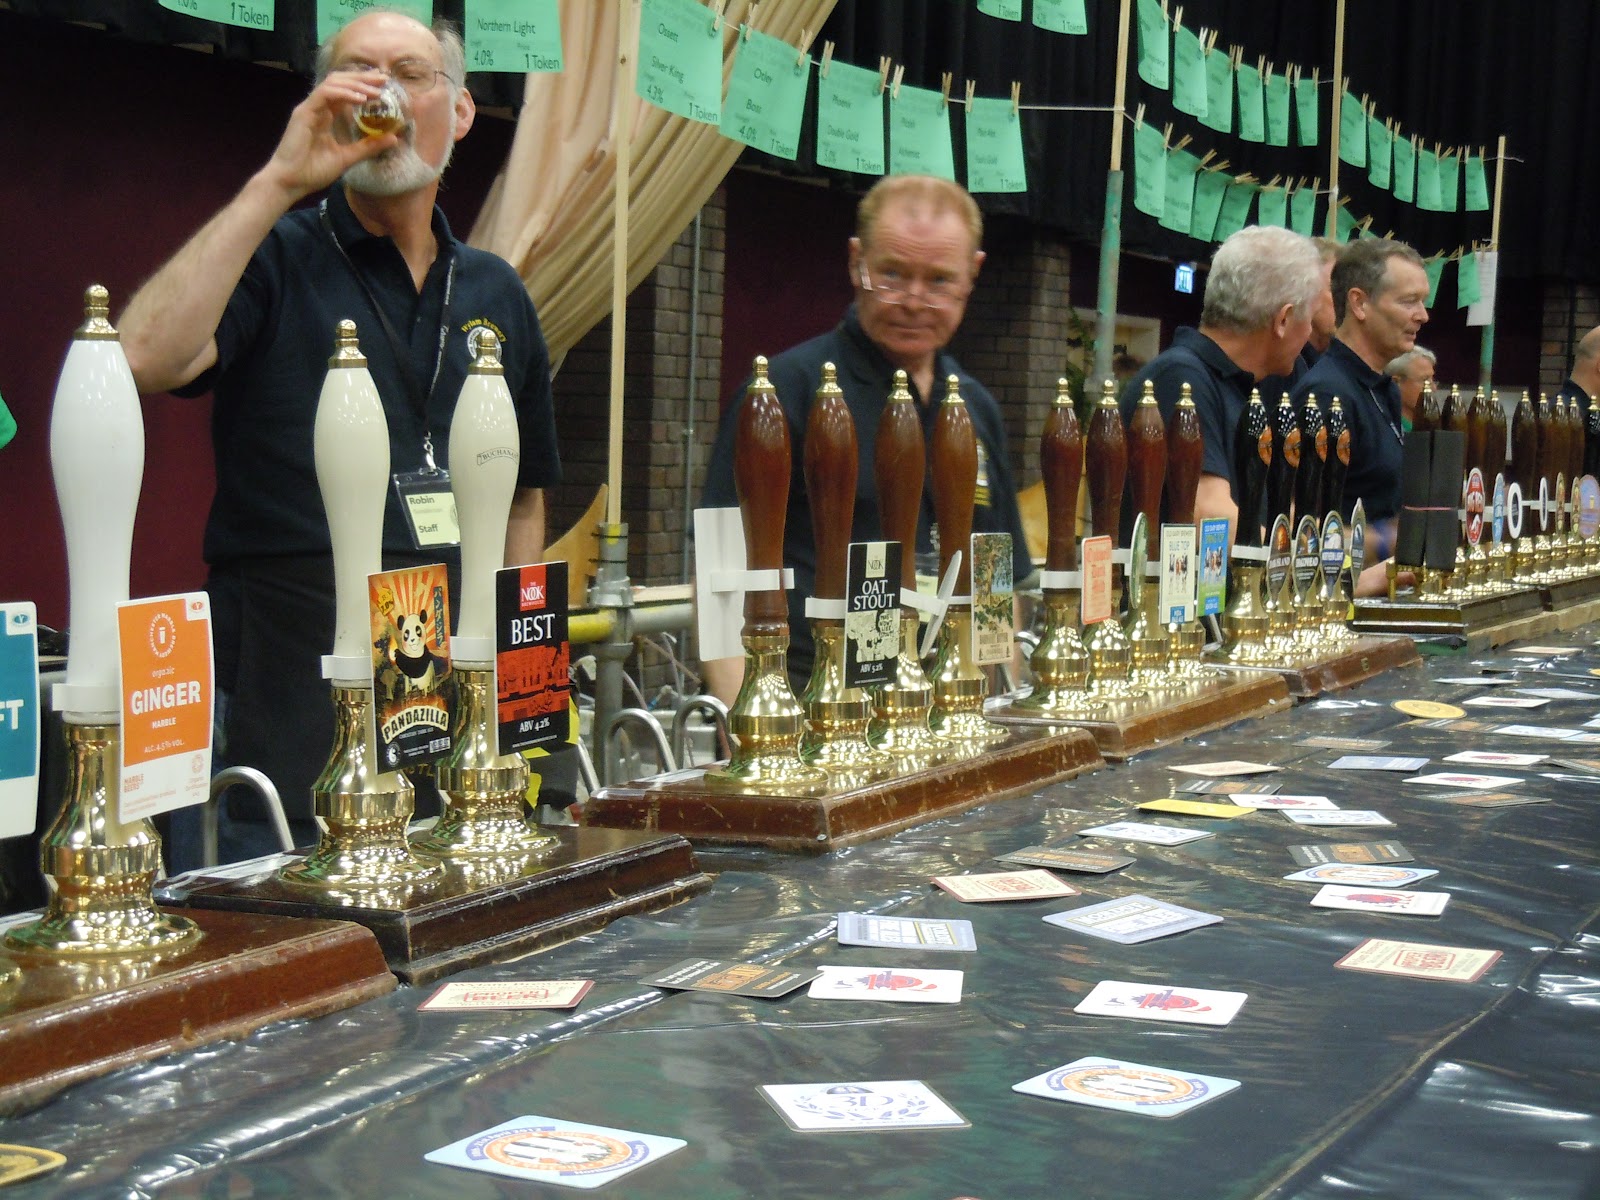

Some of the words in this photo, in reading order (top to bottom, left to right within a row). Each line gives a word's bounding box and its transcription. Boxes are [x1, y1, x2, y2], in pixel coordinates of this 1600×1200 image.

[231, 2, 235, 20] 1
[238, 4, 269, 26] Token
[477, 18, 511, 31] Northern
[513, 20, 536, 37] Light
[1066, 21, 1085, 32] Token
[474, 49, 494, 66] 4.0%
[525, 53, 530, 69] 1
[532, 54, 560, 69] Token
[668, 64, 684, 84] King
[694, 104, 718, 122] Token
[776, 140, 794, 157] Token
[861, 158, 882, 171] Token
[408, 495, 435, 505] Robin
[418, 523, 438, 534] Staff
[521, 585, 545, 602] NOOK
[861, 579, 889, 595] OAT
[853, 593, 896, 611] STOUT
[510, 613, 556, 646] BEST
[151, 665, 176, 679] organic
[860, 663, 871, 674] ABV
[131, 680, 202, 716] GINGER
[151, 717, 177, 729] MARBLE
[383, 707, 447, 740] PANDAZILLA
[519, 719, 533, 734] ABV
[534, 716, 551, 732] 4.2%
